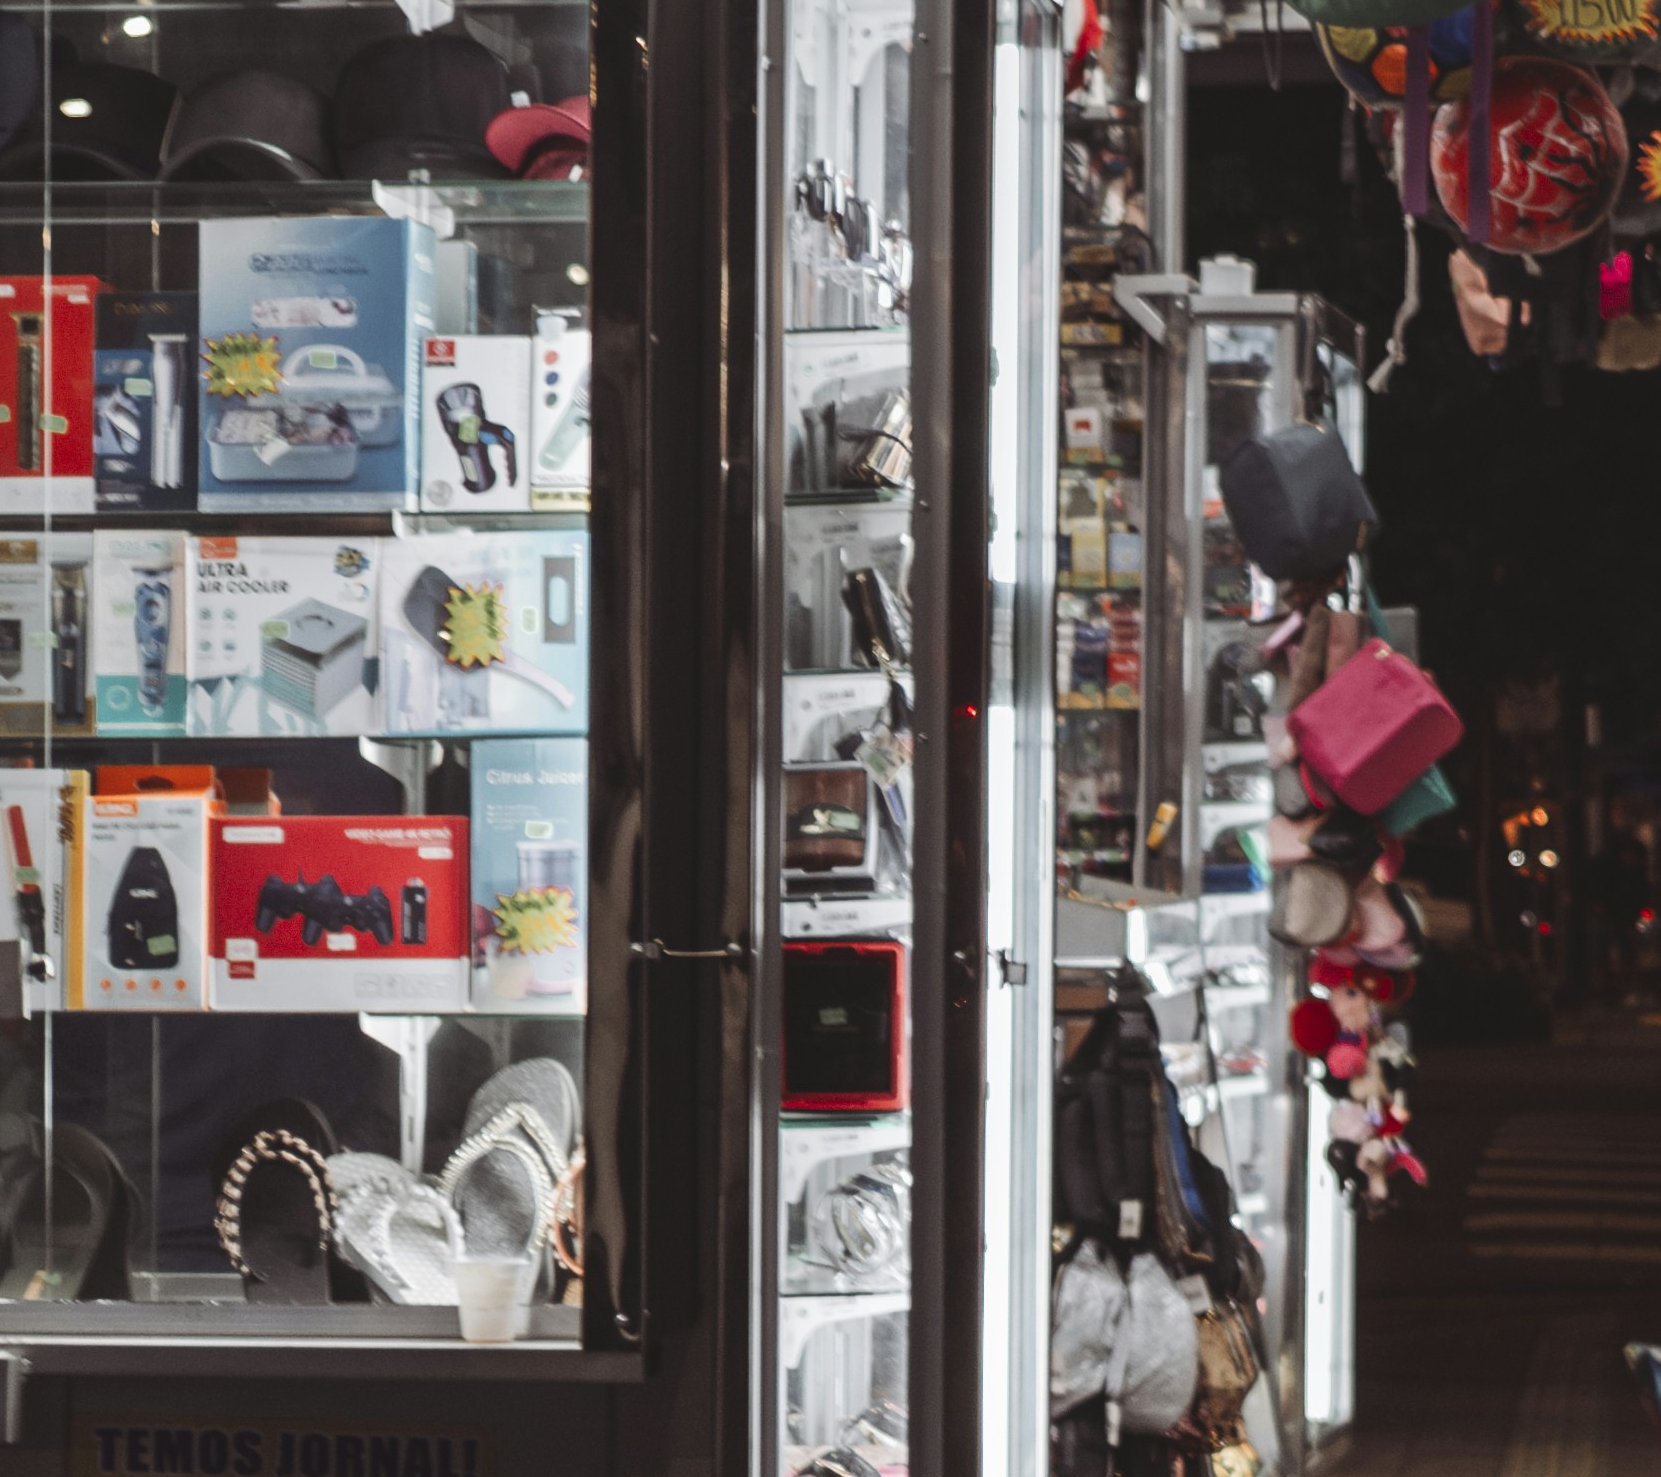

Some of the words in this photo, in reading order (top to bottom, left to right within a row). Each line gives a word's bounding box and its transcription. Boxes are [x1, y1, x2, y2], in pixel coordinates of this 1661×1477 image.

[197, 562, 248, 577] ULTRA
[197, 581, 221, 593] AIR
[227, 581, 290, 594] COOLER
[94, 1428, 262, 1477] TEMOS
